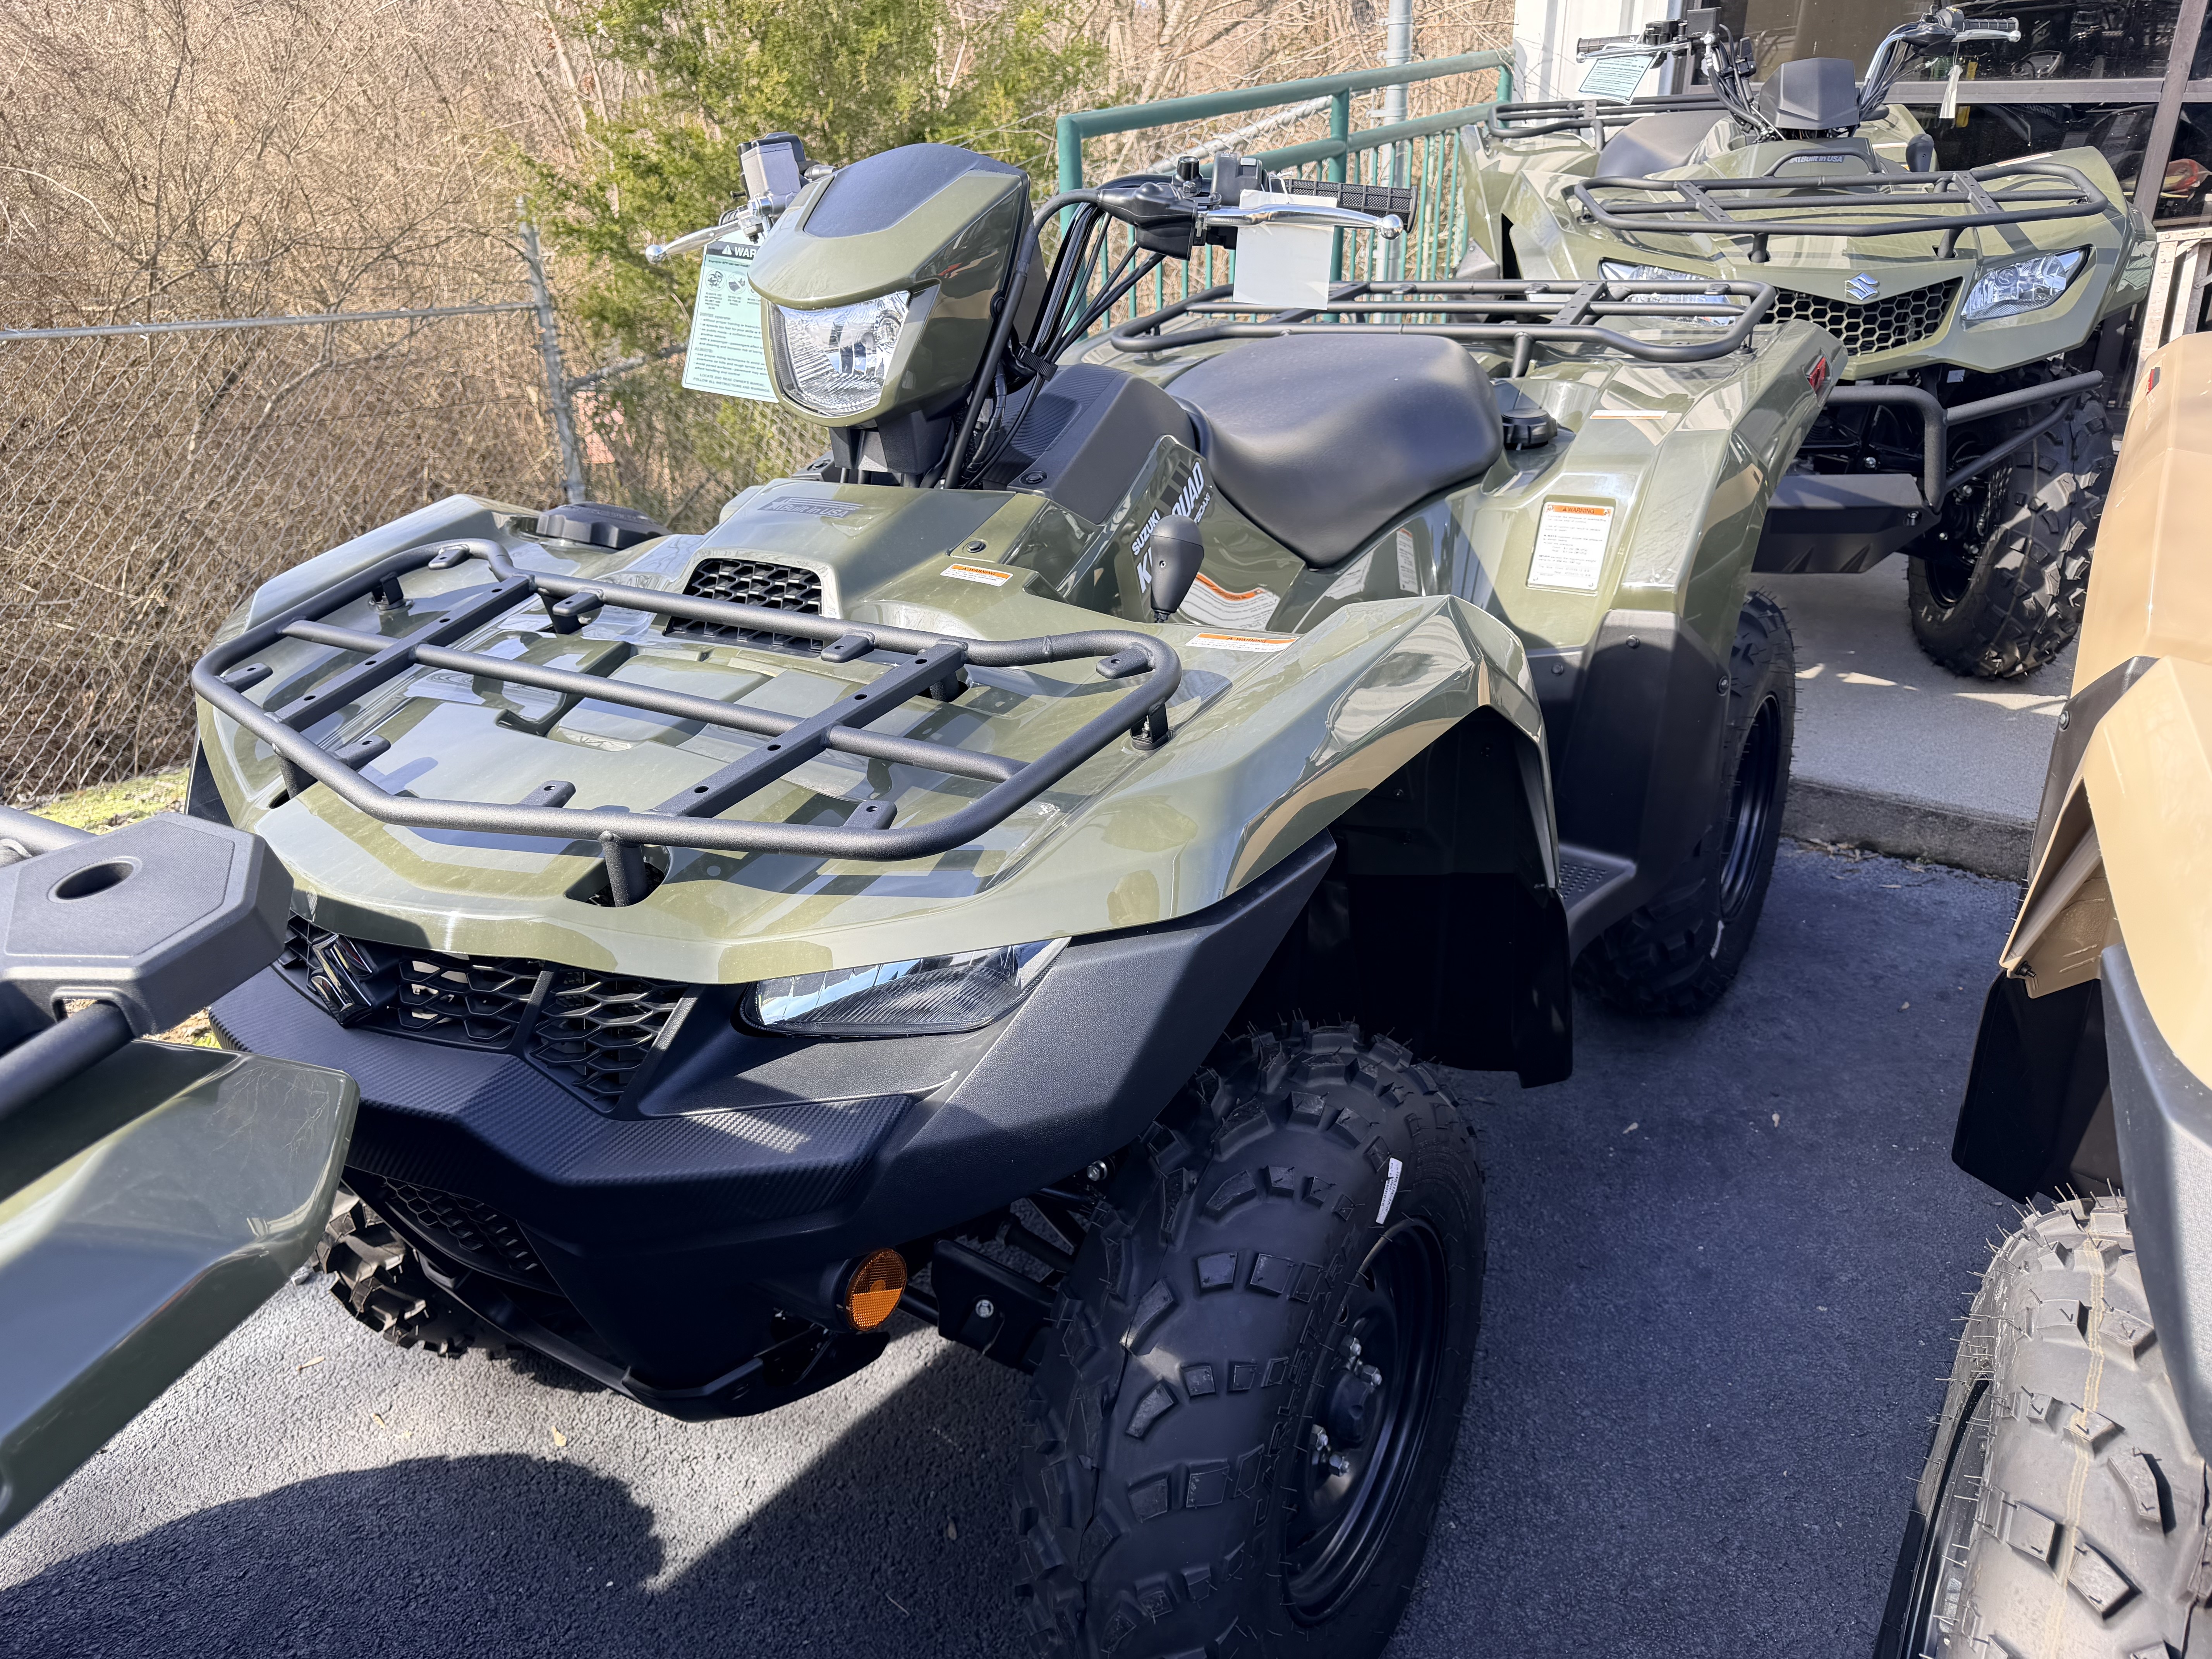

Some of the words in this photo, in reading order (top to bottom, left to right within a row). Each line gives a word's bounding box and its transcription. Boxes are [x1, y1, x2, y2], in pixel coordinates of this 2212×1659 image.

[782, 504, 809, 512] Built
[819, 508, 848, 517] USA
[1132, 509, 1161, 556] SUZUKI
